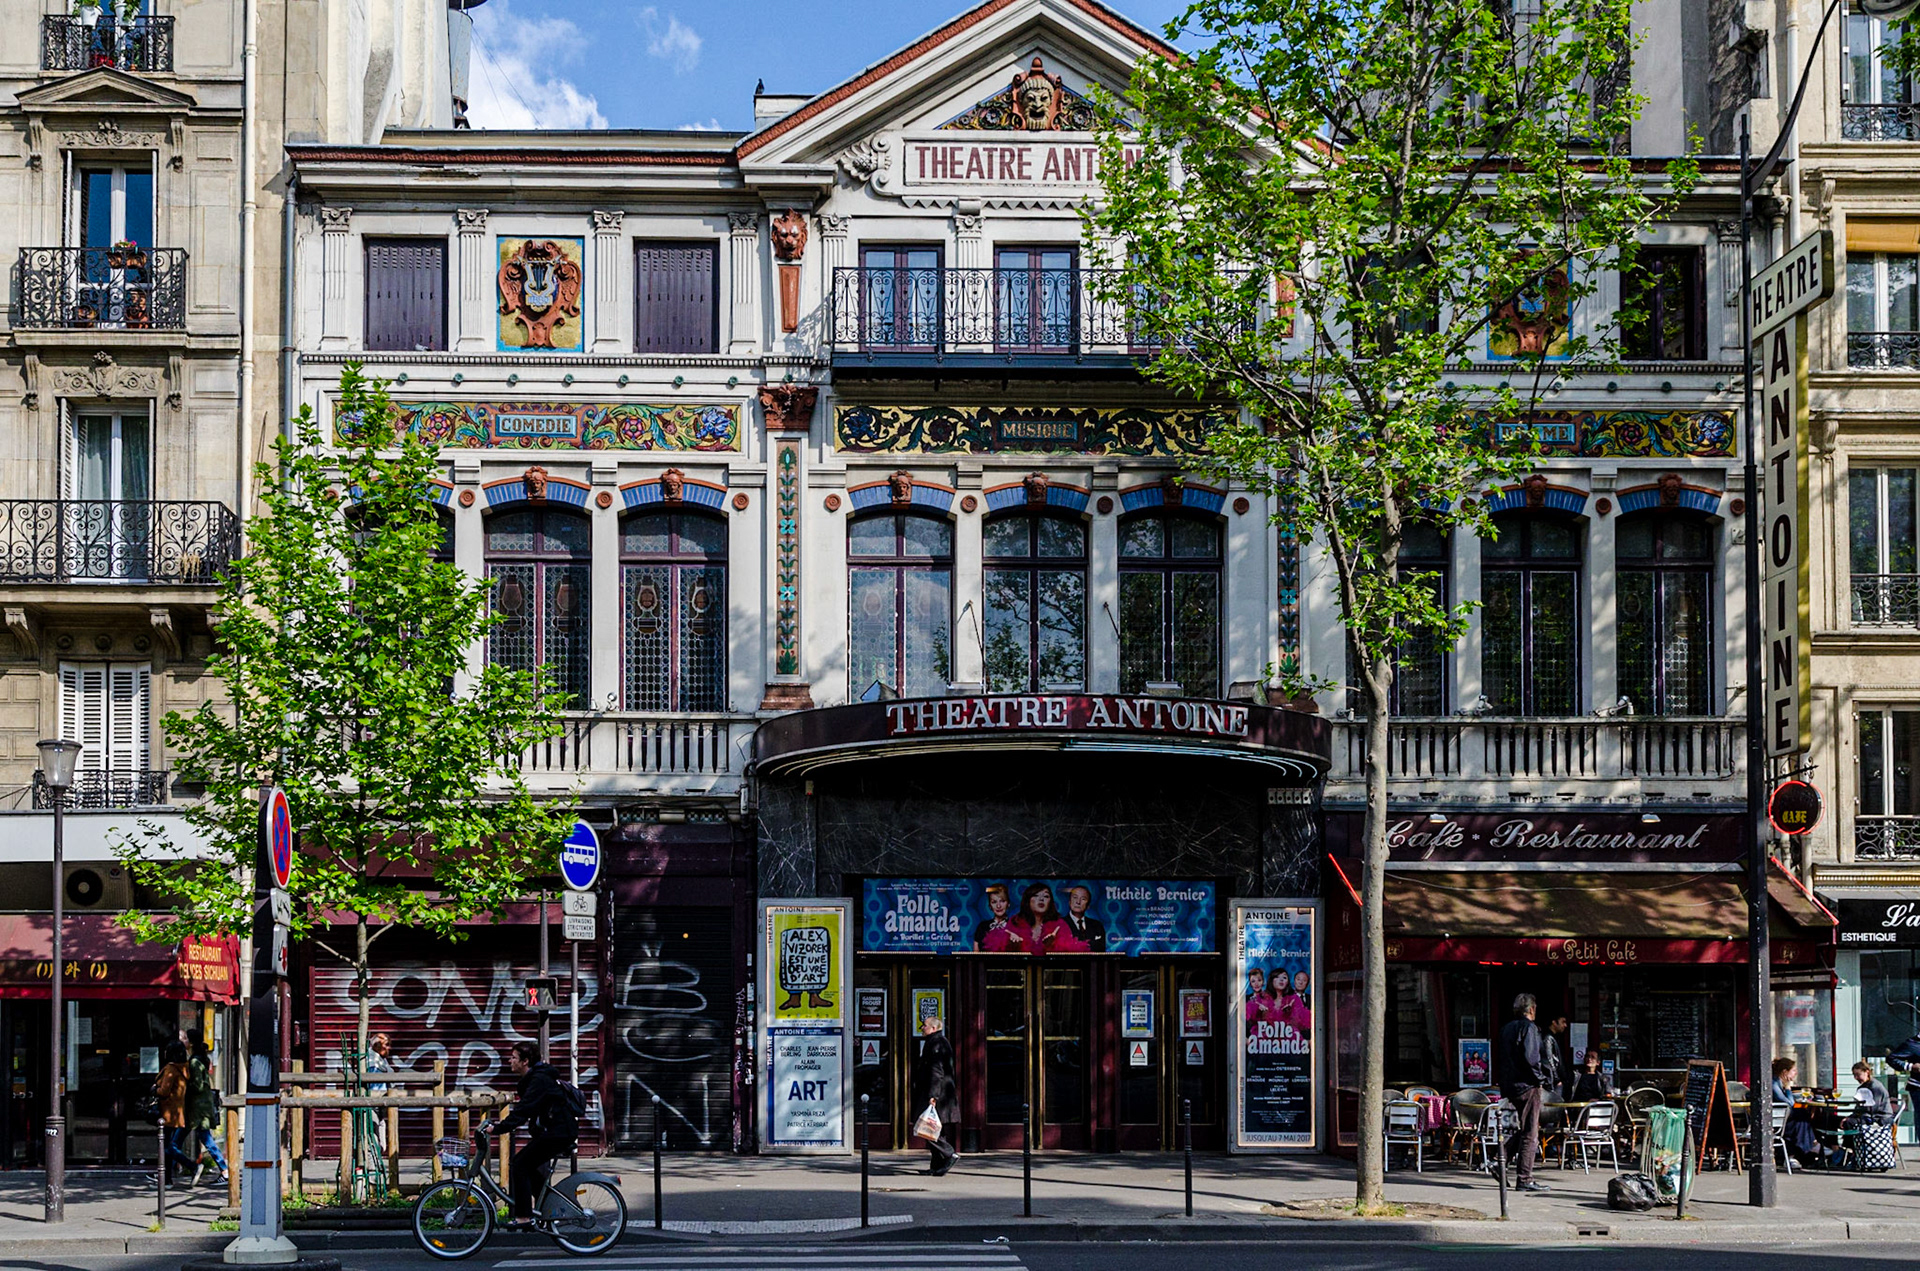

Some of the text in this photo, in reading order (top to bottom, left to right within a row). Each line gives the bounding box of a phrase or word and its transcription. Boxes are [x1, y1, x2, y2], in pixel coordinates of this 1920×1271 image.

[915, 146, 1032, 180] THEATRE
[501, 418, 571, 433] COMEDIE
[1002, 422, 1075, 438] MUSIQUE
[1770, 326, 1792, 751] ANTOINE
[886, 698, 1249, 736] THEATRE ANTOINE
[1386, 819, 1709, 860] Café Restaurant
[1105, 885, 1205, 900] Michèle Bernier
[897, 894, 939, 914] Folle
[1245, 911, 1290, 920] ANTOINE
[790, 930, 824, 942] ALEX
[1841, 932, 1897, 942] ESTHETIQUE
[188, 944, 221, 962] RESTAURANT
[786, 942, 828, 955] VIZOREK
[1281, 948, 1310, 957] Bernier
[1563, 939, 1599, 960] Petit
[1606, 939, 1637, 960] Café
[788, 954, 826, 965] EST UNE
[203, 964, 229, 981] SICHUAN
[790, 973, 826, 983] D'ART
[1257, 1020, 1293, 1038] Folle
[1283, 1134, 1296, 1142] MAI
[1297, 1134, 1311, 1142] 2017
